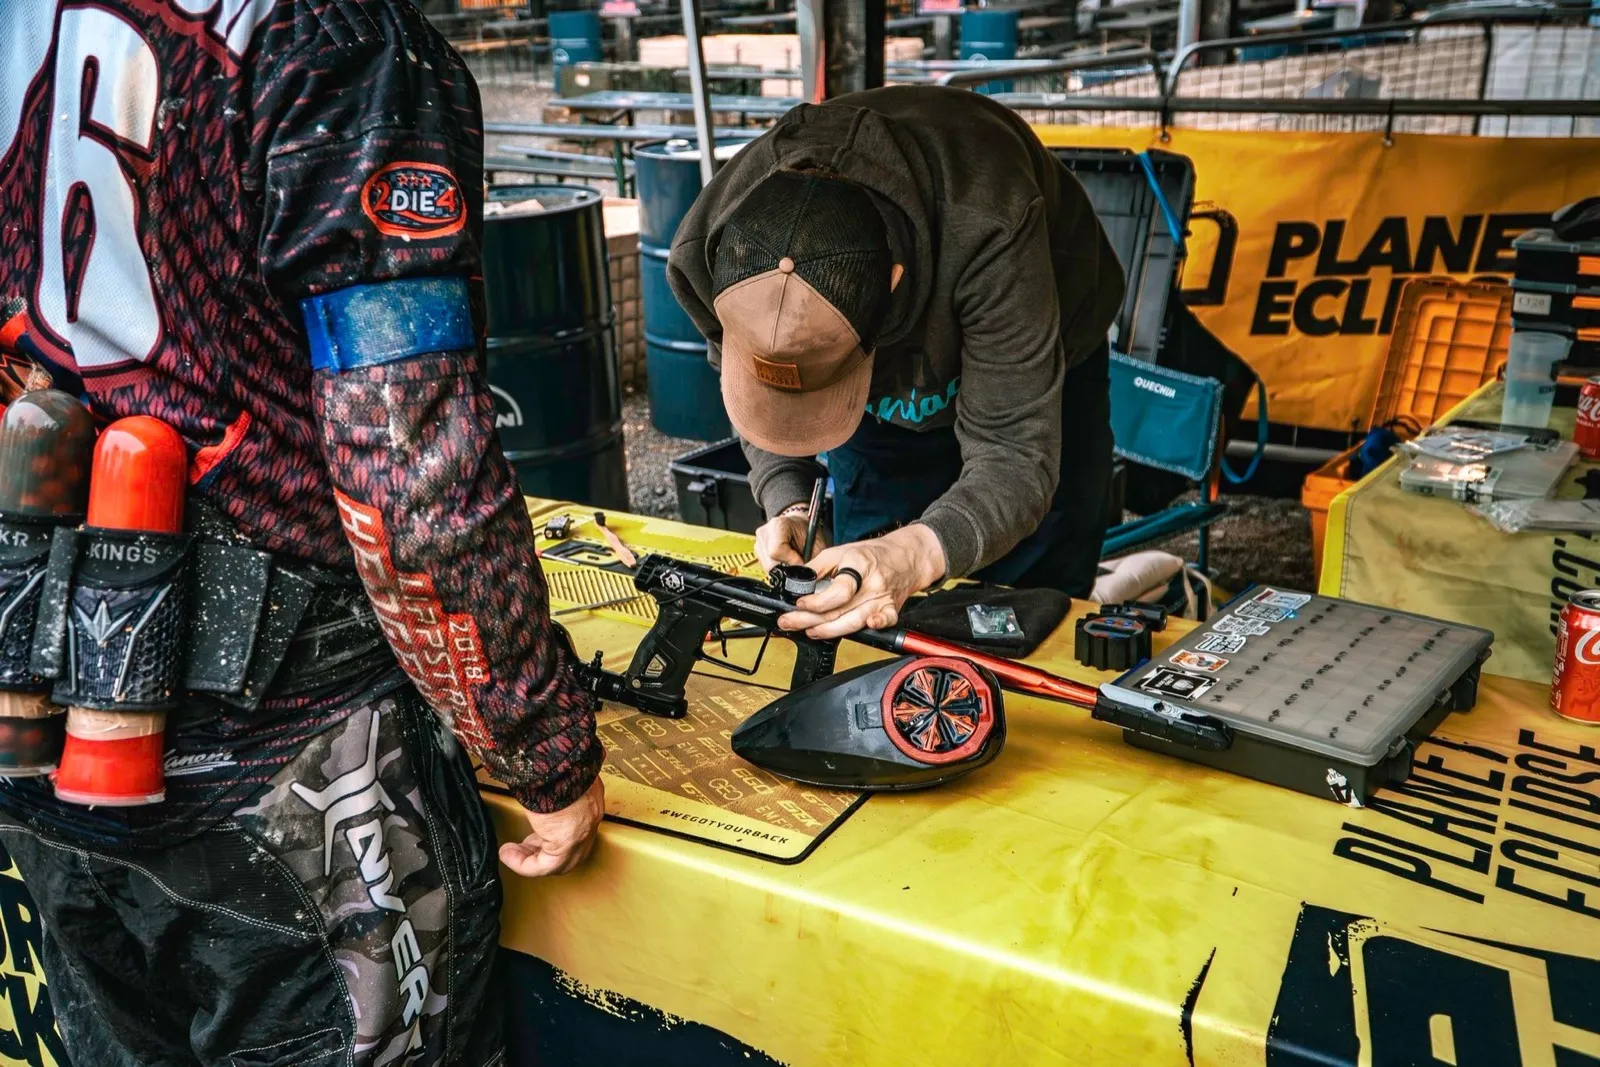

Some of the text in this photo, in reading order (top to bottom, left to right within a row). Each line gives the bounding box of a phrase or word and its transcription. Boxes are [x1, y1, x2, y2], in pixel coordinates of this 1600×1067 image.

[373, 180, 457, 213] 2DIE4
[1266, 213, 1552, 278] PLANE
[1249, 277, 1405, 337] ECLI
[1133, 376, 1176, 399] QUECHUA
[90, 542, 157, 565] KINGS
[448, 620, 485, 682] 2018
[668, 717, 695, 733] GO
[660, 807, 790, 846] #WEGOTYOURBACK
